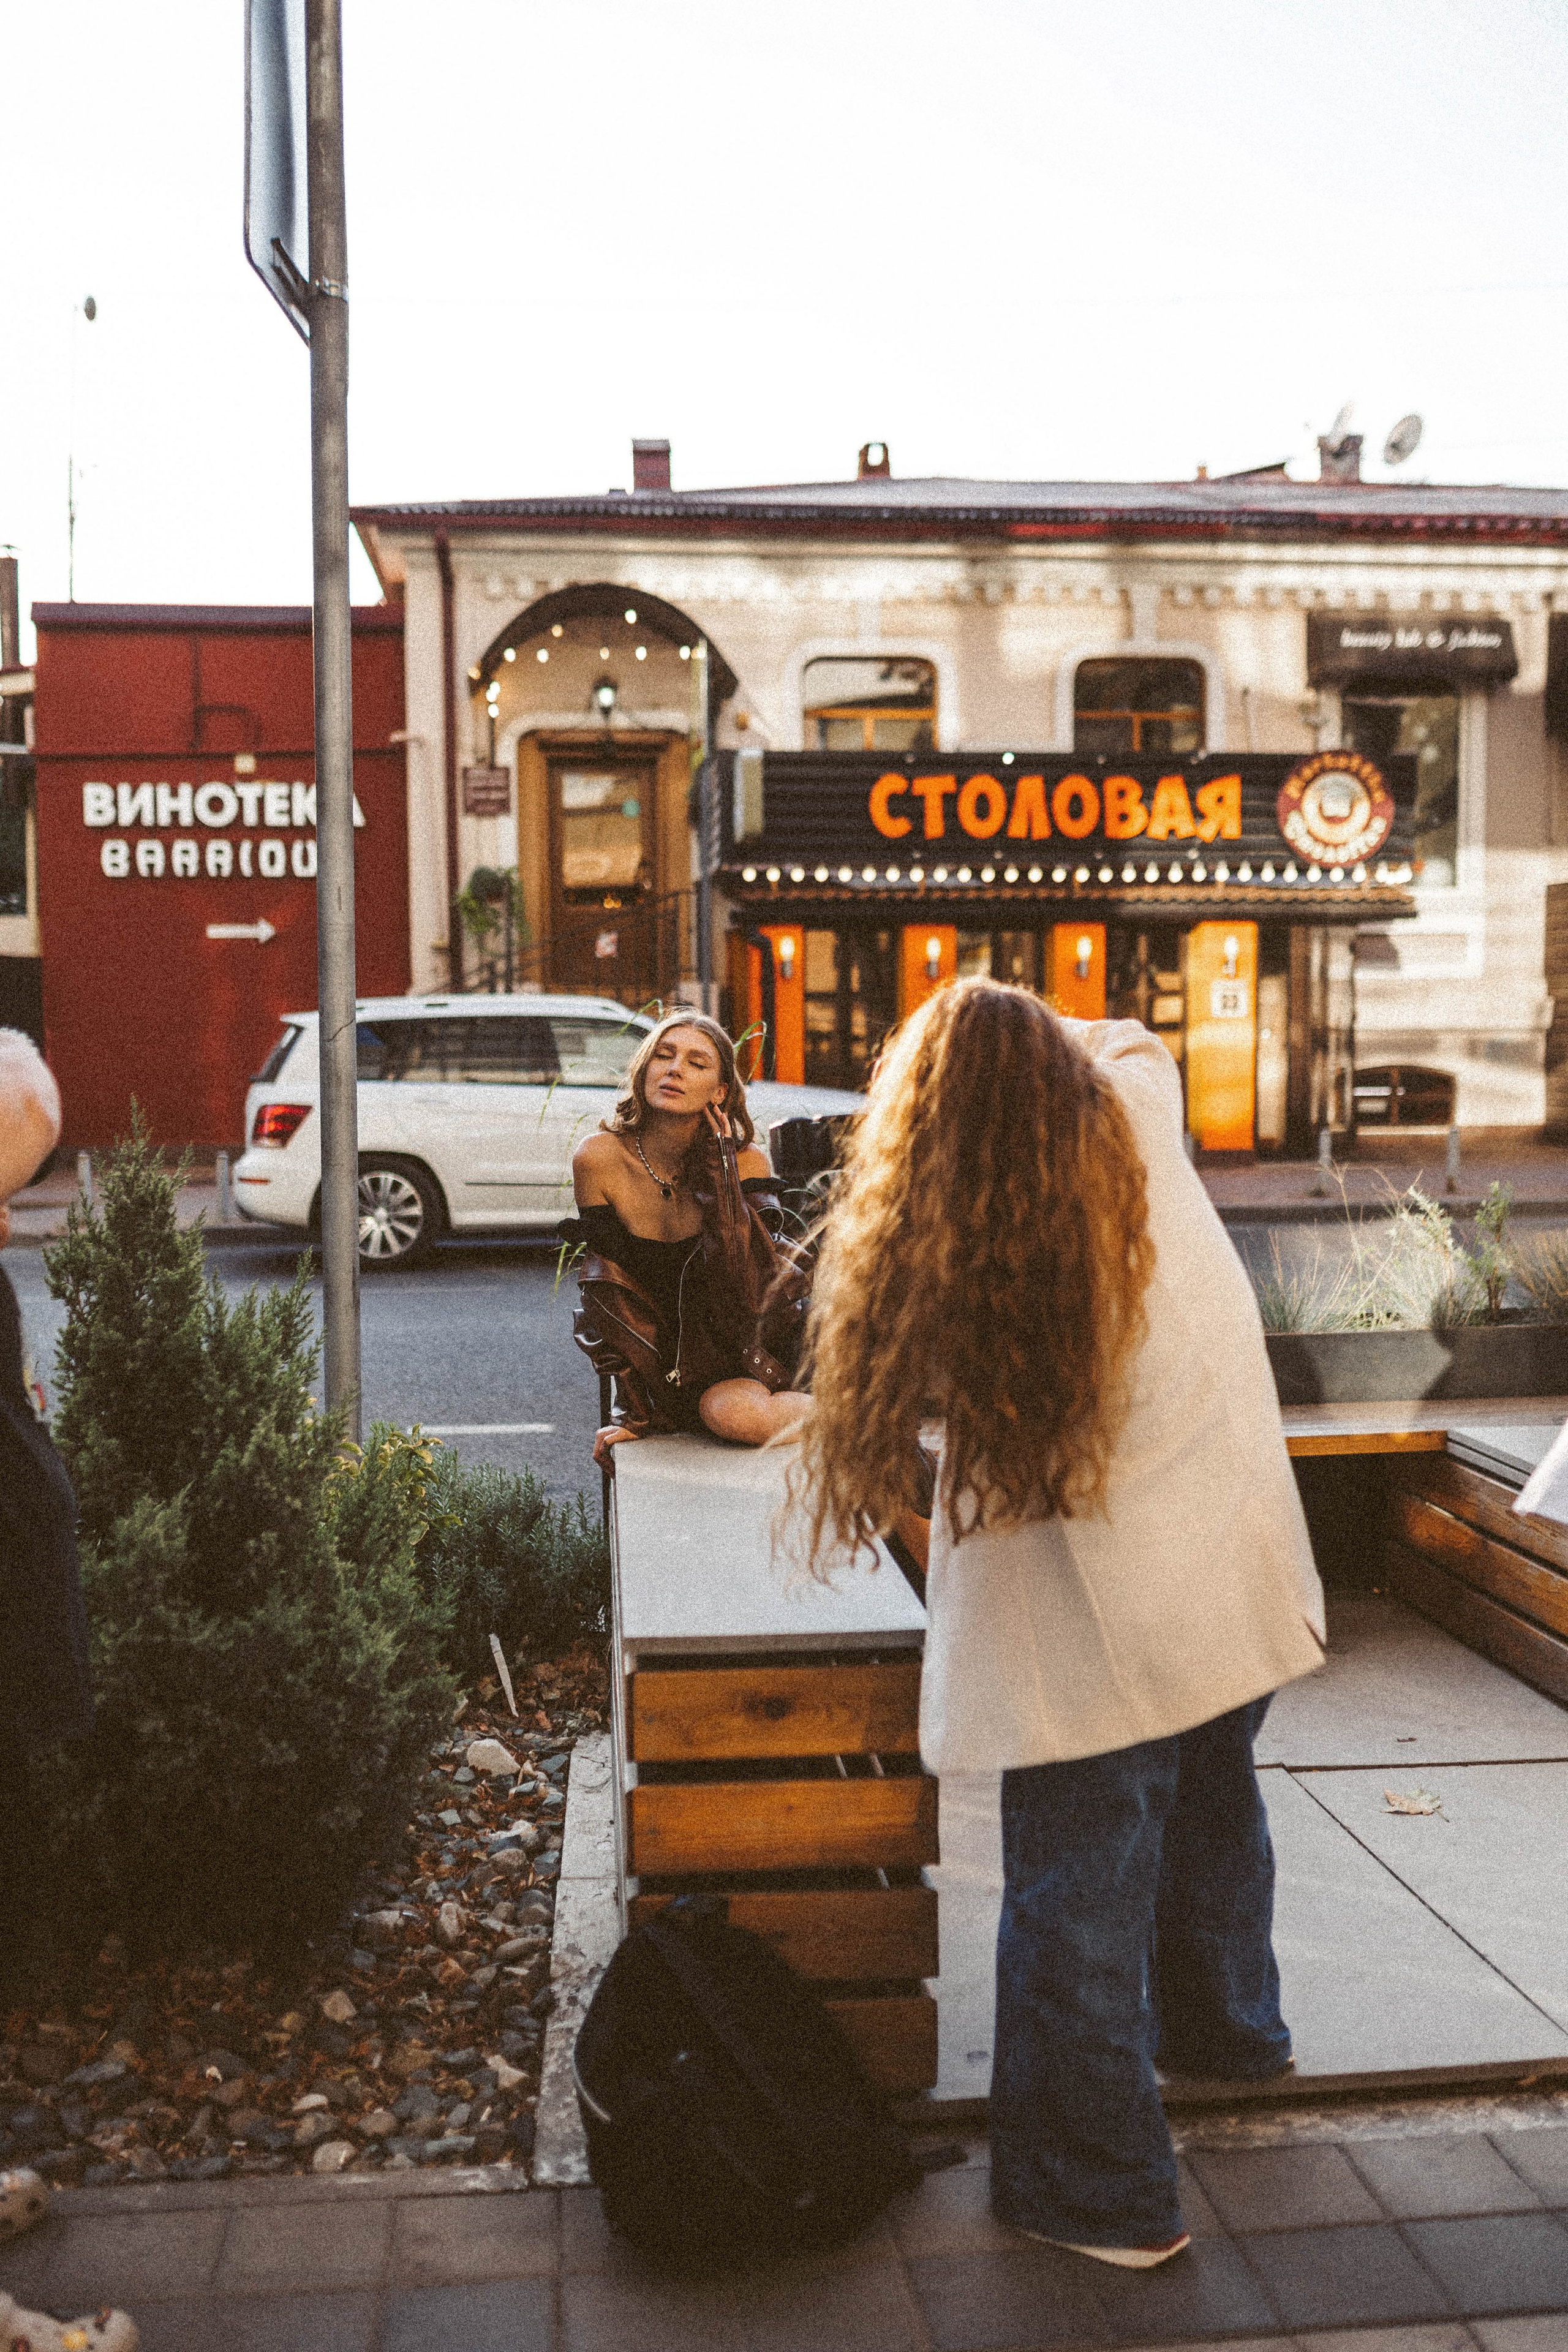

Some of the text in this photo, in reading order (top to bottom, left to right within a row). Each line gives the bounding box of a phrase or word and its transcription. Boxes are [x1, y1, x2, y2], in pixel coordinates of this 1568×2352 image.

[83, 782, 365, 827] ВИНОТЕК
[869, 773, 1242, 843] СТОЛОВАЯ
[100, 839, 317, 877] BARRIQU
